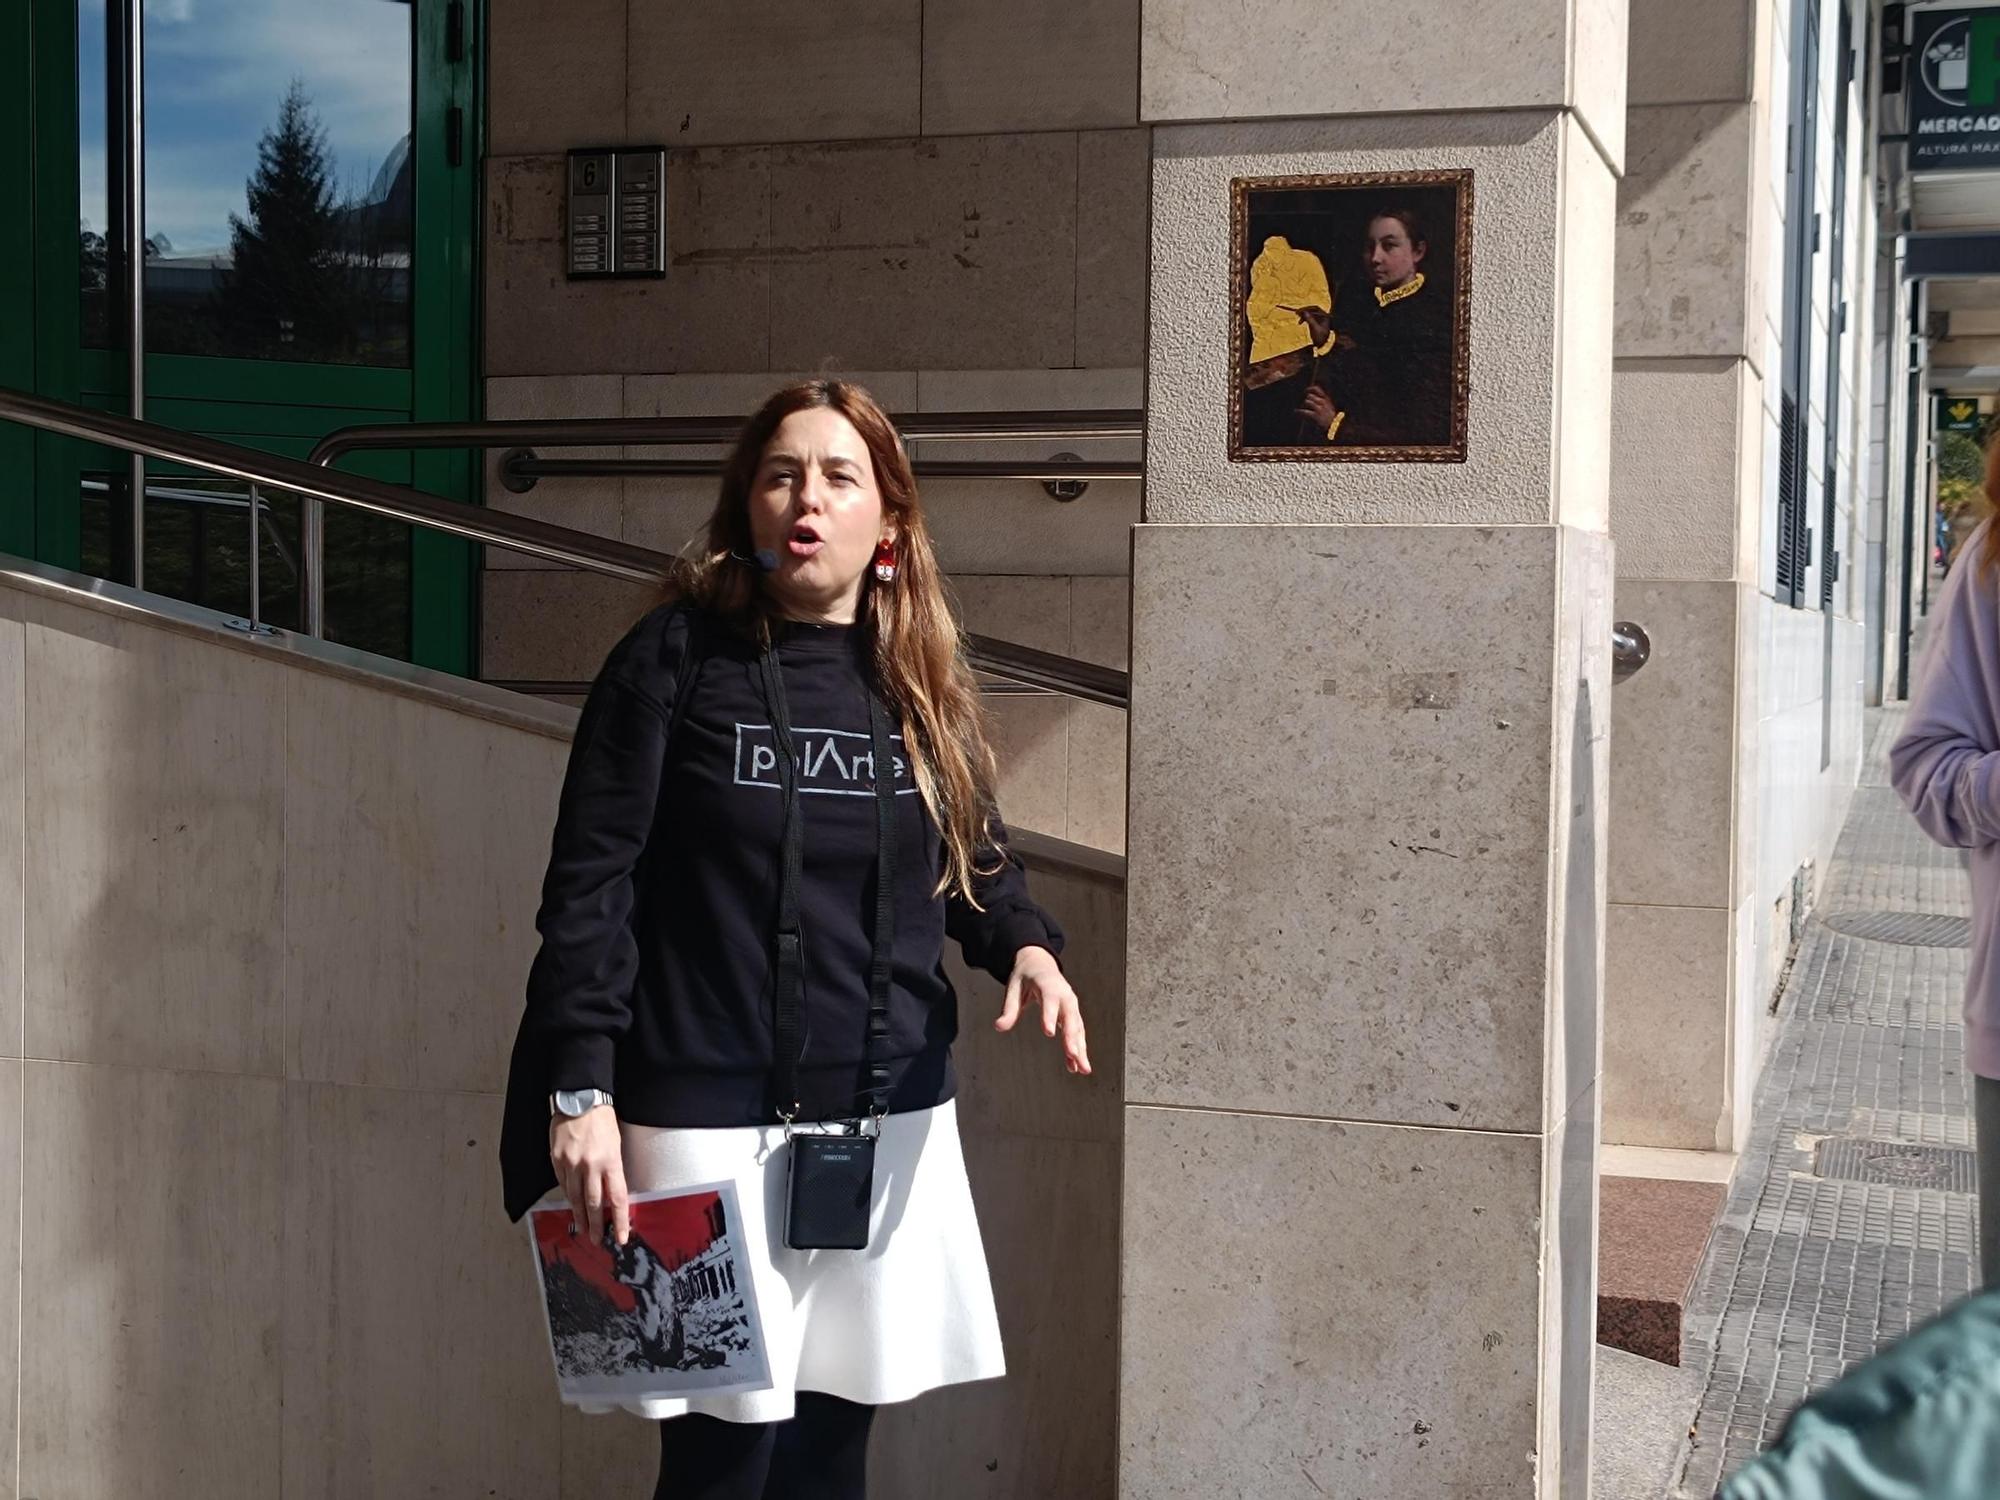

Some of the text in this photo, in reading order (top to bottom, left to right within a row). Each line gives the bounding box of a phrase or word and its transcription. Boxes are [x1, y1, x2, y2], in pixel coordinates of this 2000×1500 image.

[1918, 115, 2000, 134] MERCAD
[1917, 144, 1968, 155] ALTURA
[583, 162, 596, 187] 6
